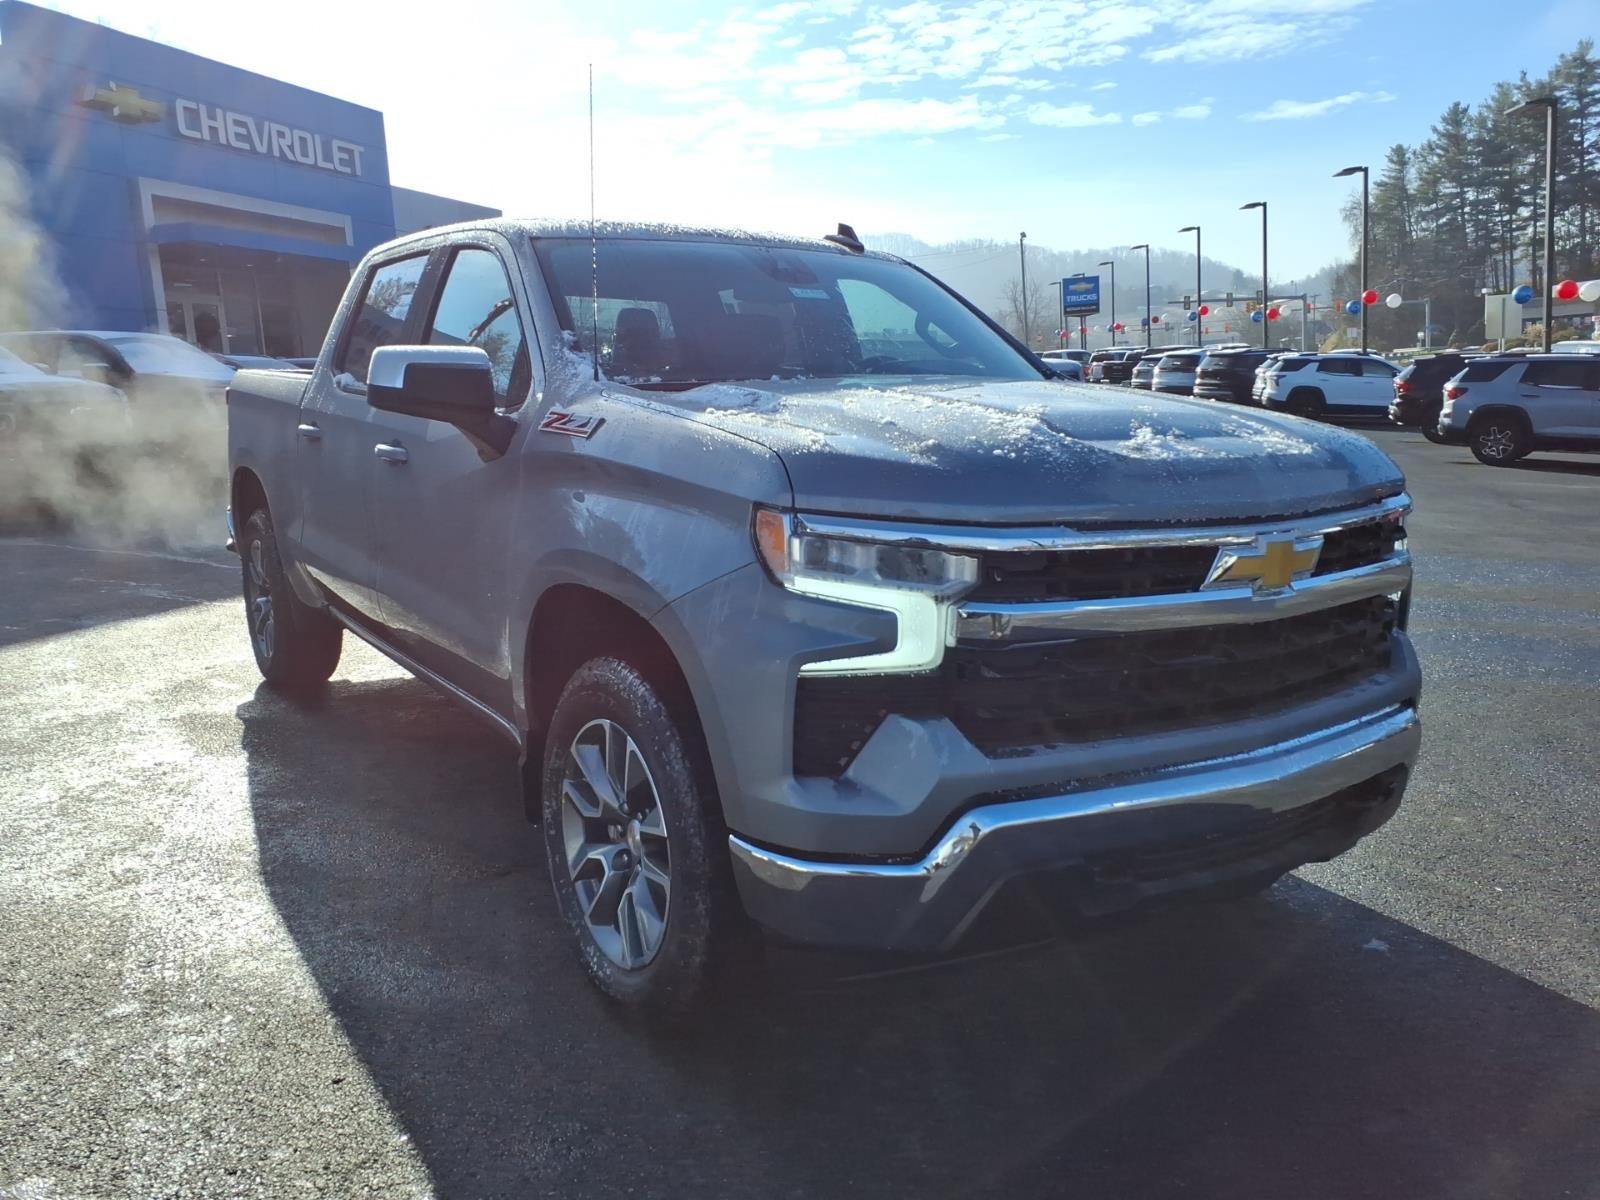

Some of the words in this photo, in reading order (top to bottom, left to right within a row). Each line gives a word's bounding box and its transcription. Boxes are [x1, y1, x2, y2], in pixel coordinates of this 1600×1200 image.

[176, 98, 364, 176] CHEVROLET
[1066, 294, 1097, 302] TRUCKS
[539, 410, 605, 438] Z71
